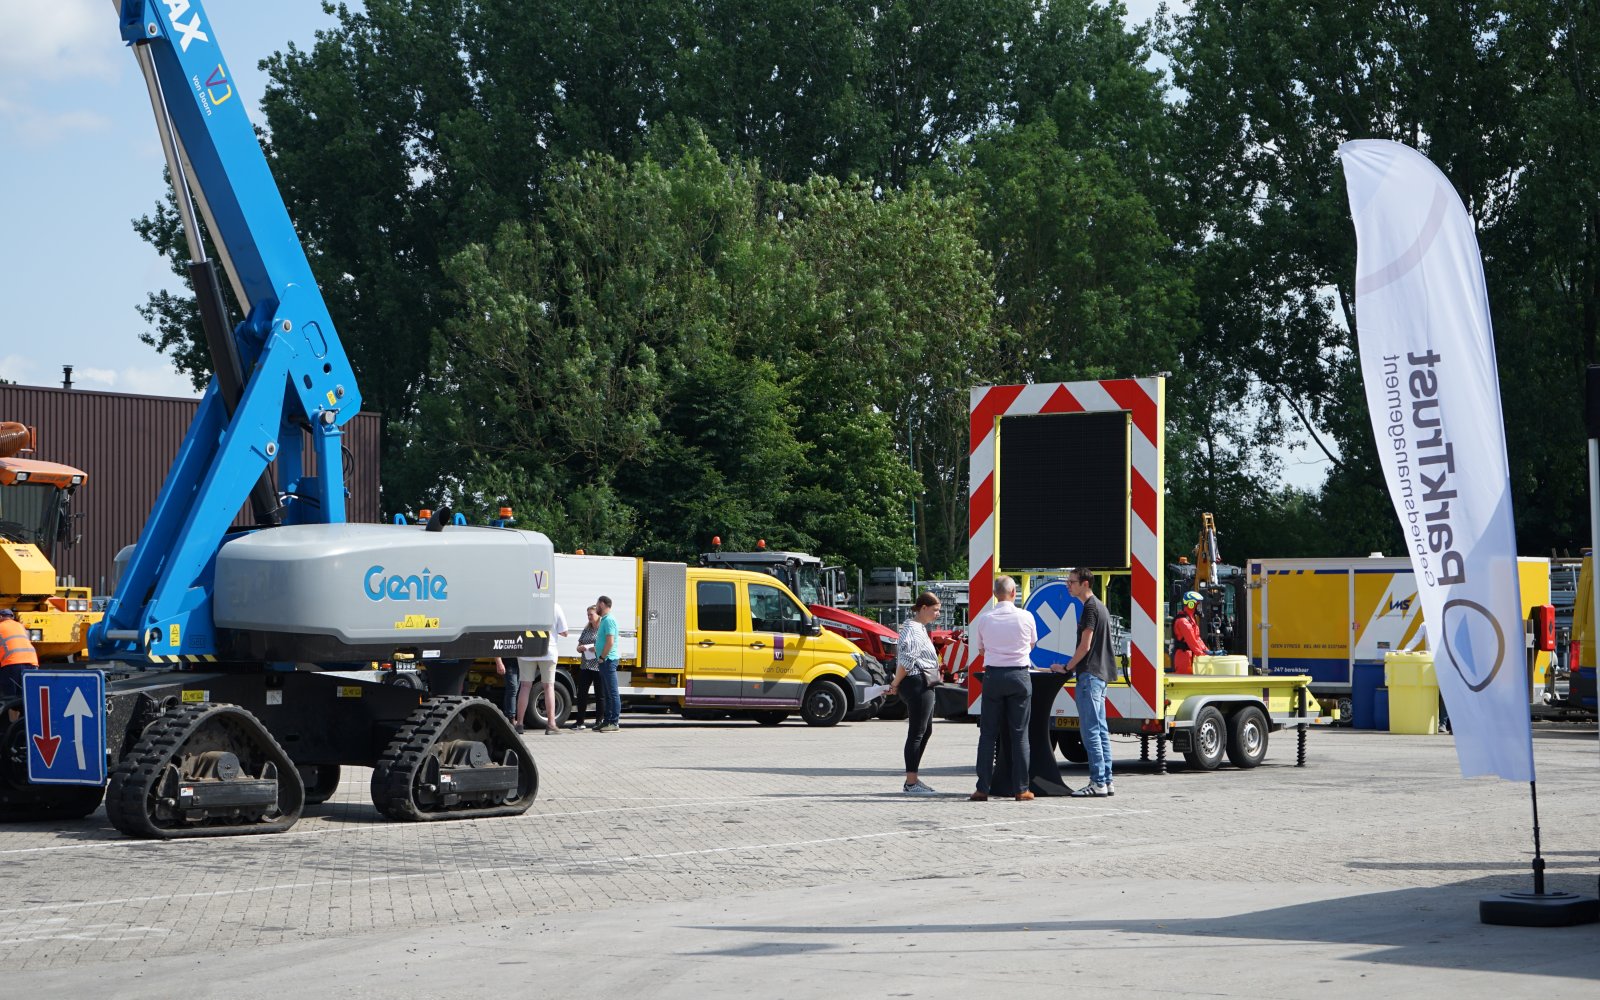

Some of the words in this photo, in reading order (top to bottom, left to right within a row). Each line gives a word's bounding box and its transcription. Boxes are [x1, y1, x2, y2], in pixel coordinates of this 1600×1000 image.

[192, 75, 201, 92] Van
[199, 91, 212, 116] Doorn
[364, 565, 447, 601] Genie
[493, 639, 503, 650] XC
[776, 665, 794, 674] Doorn
